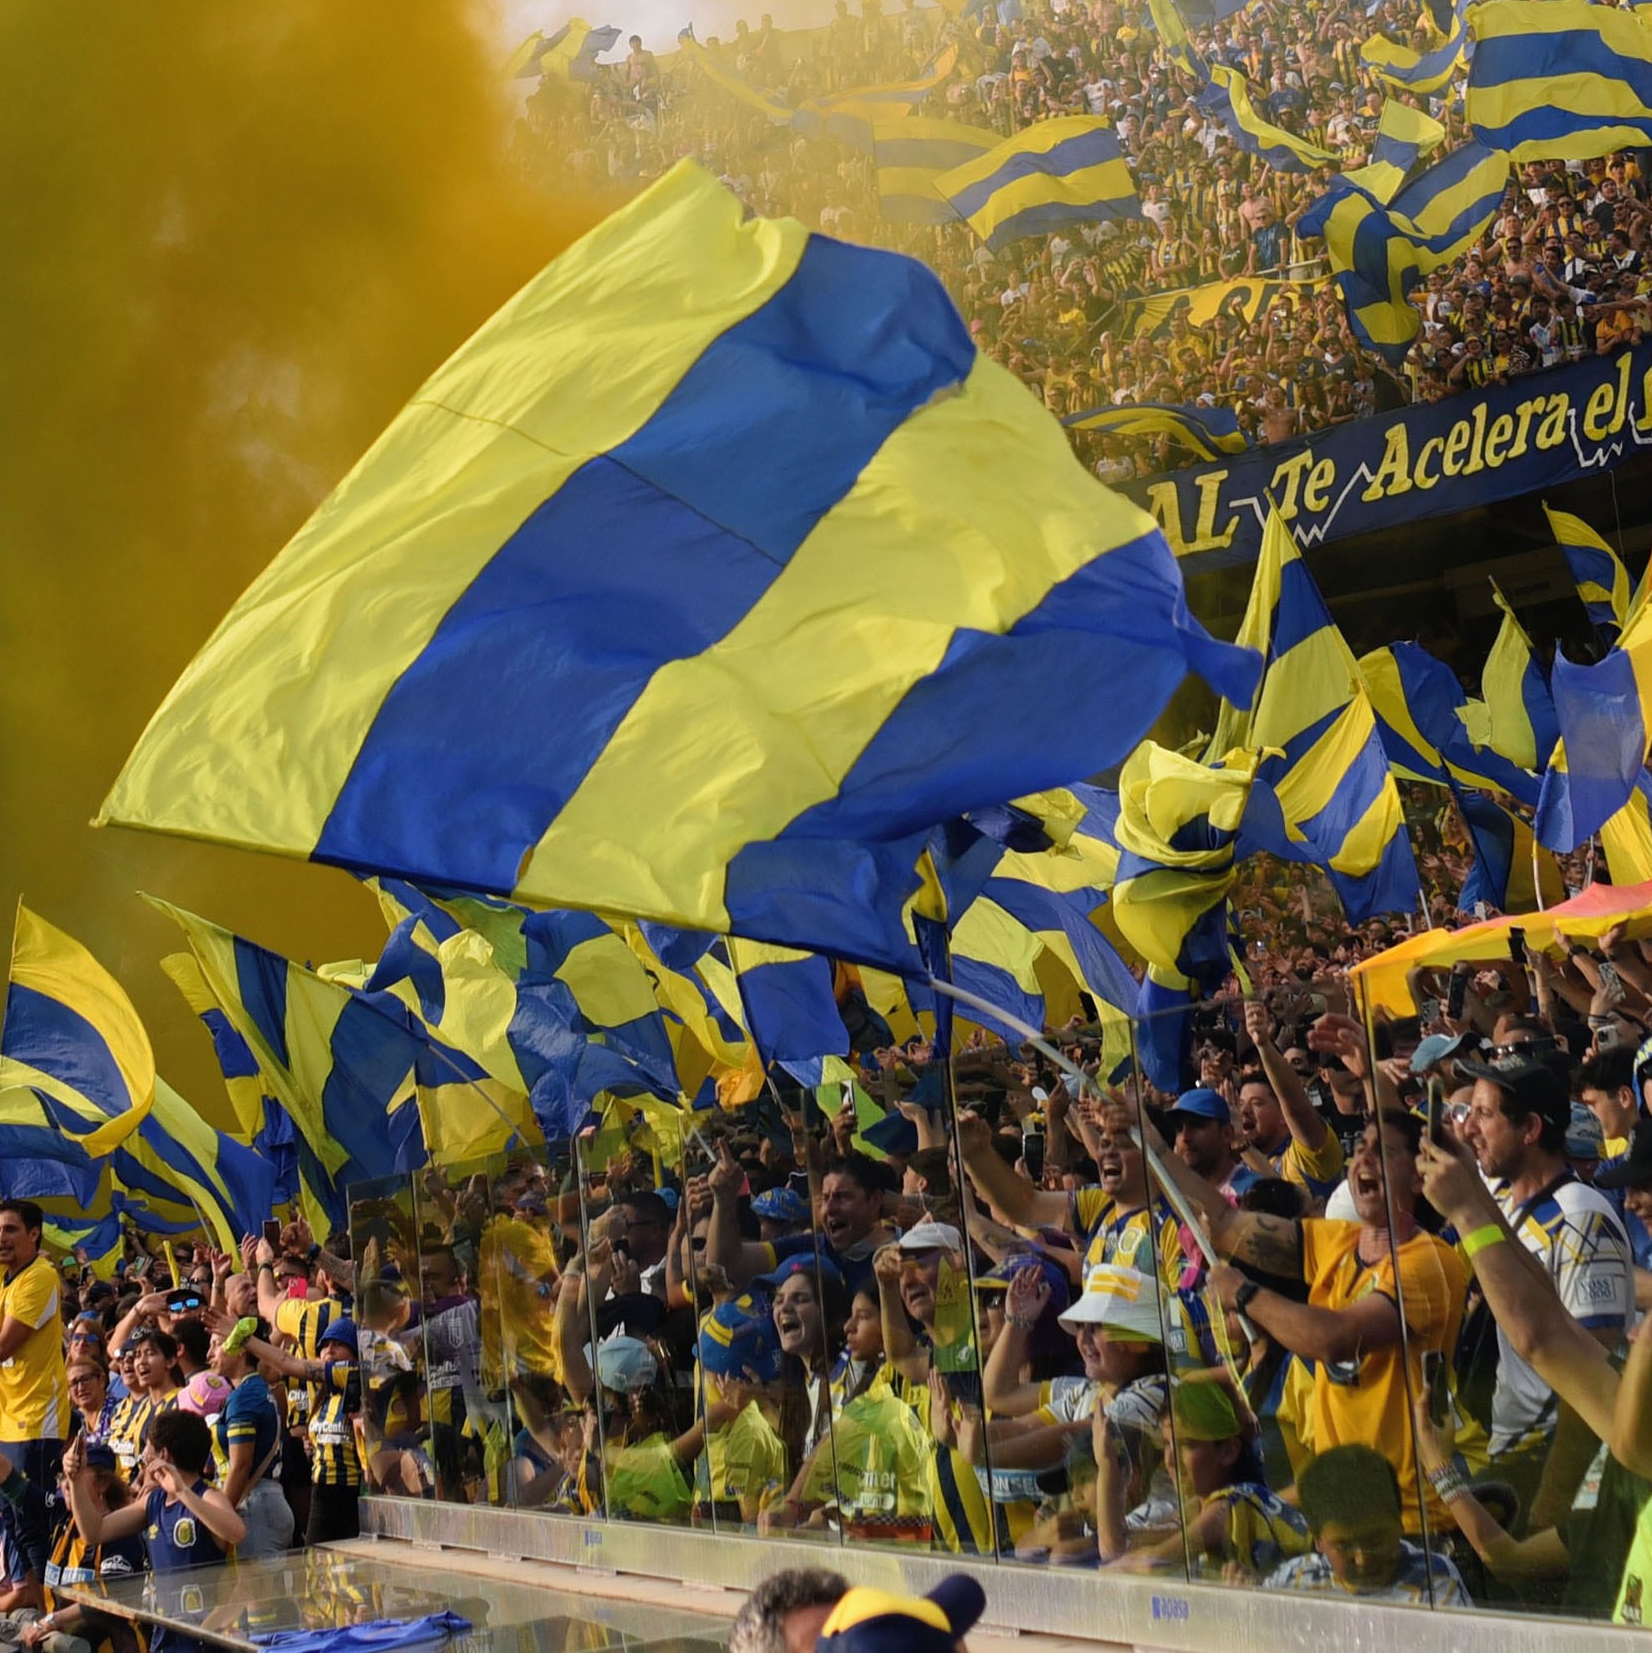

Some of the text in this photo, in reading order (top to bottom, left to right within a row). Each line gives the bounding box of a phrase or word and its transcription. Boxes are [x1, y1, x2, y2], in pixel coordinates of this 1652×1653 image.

[1271, 448, 1336, 521] Te
[1361, 392, 1569, 504] Acelera
[1586, 350, 1633, 441] el
